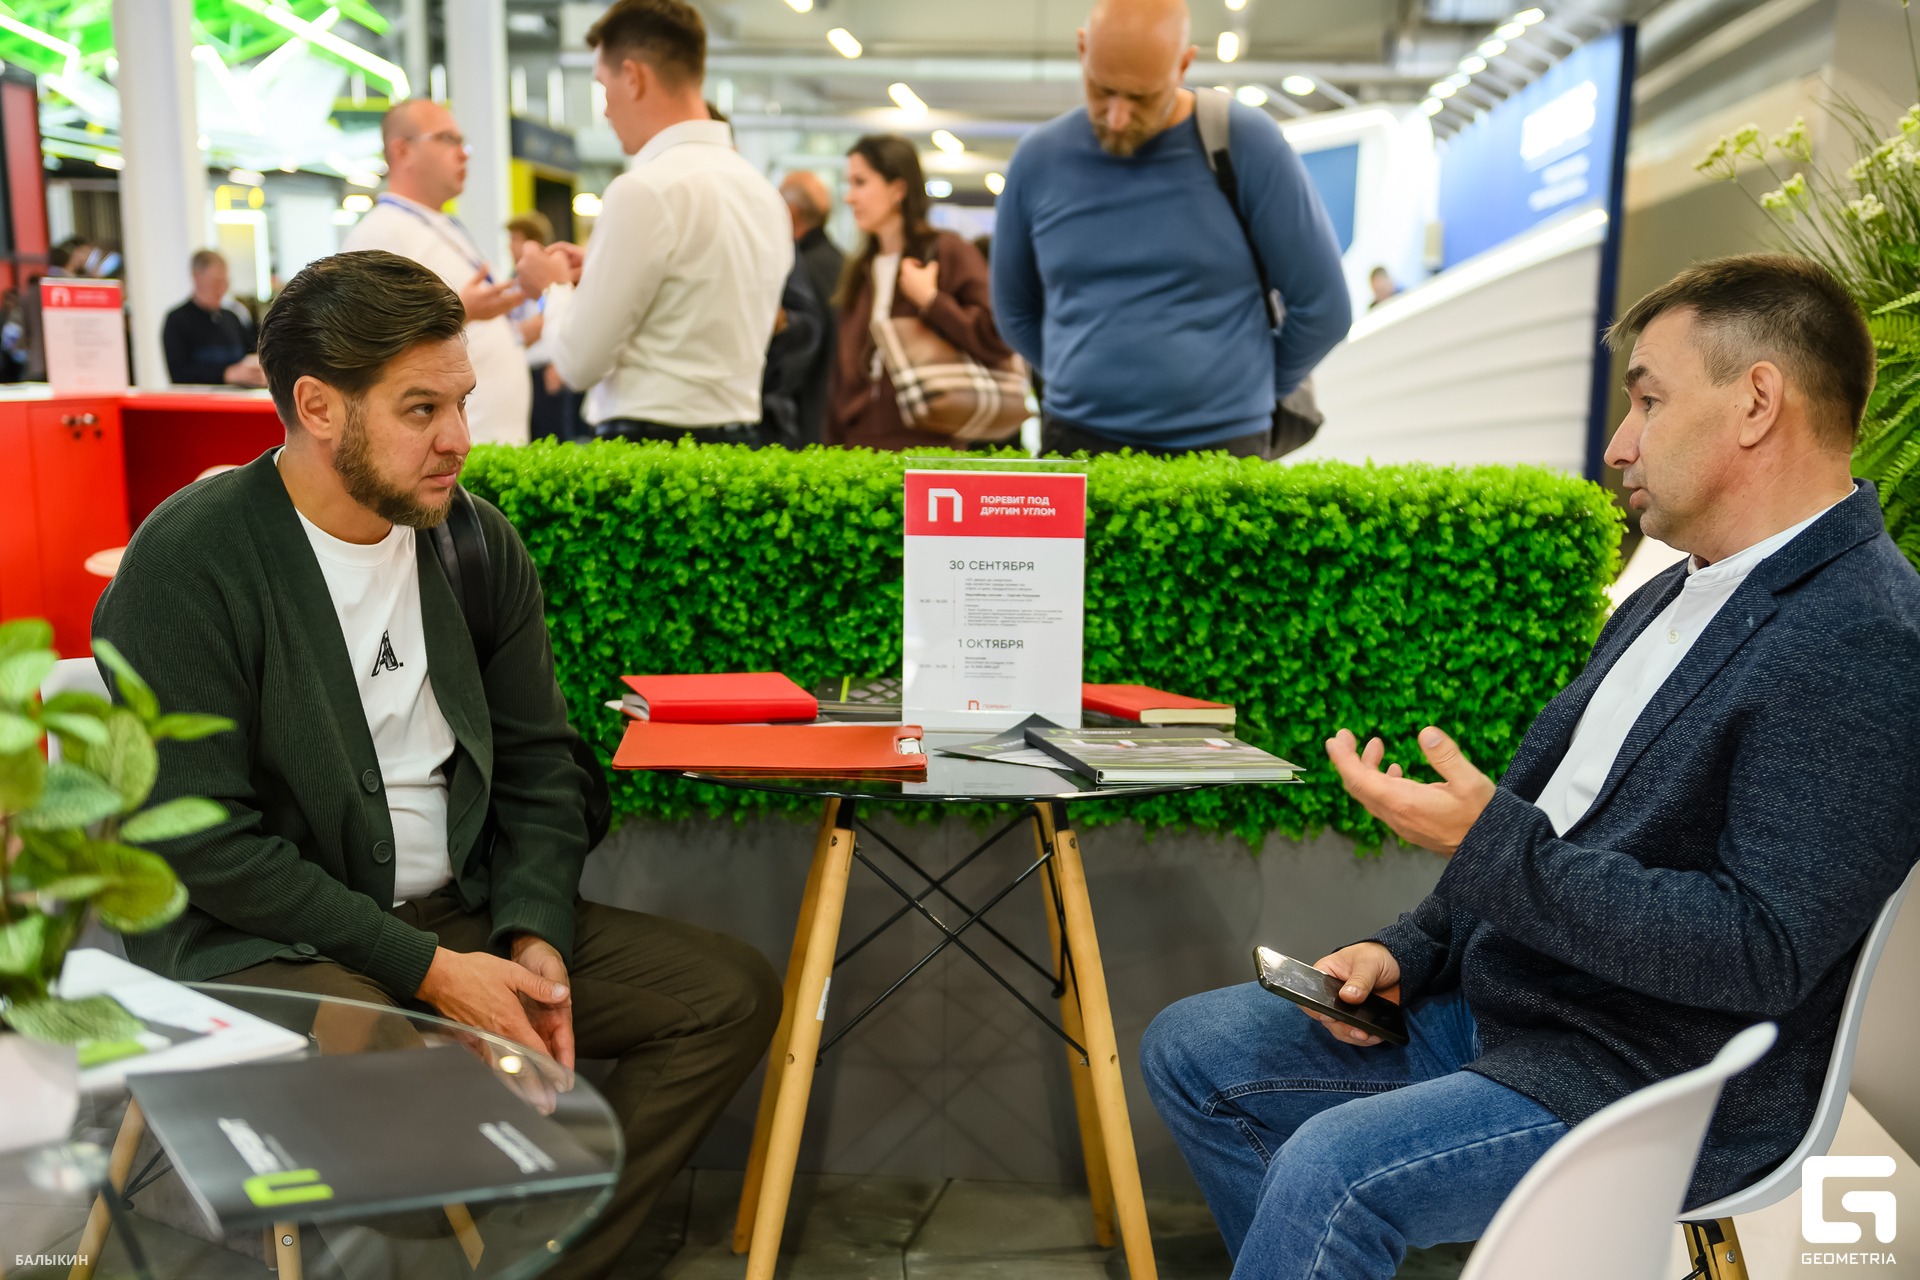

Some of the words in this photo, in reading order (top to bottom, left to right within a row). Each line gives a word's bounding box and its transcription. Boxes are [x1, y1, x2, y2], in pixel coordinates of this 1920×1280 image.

[980, 496, 1026, 505] ПОРЕВИТ
[1027, 496, 1050, 506] ПОД
[980, 506, 1021, 516] ДРУГИМ
[1023, 507, 1056, 516] УГЛОМ
[949, 560, 965, 570] 30
[969, 560, 1035, 571] СЕНТЯБРЯ
[966, 638, 1024, 649] ОКТЯБРЯ
